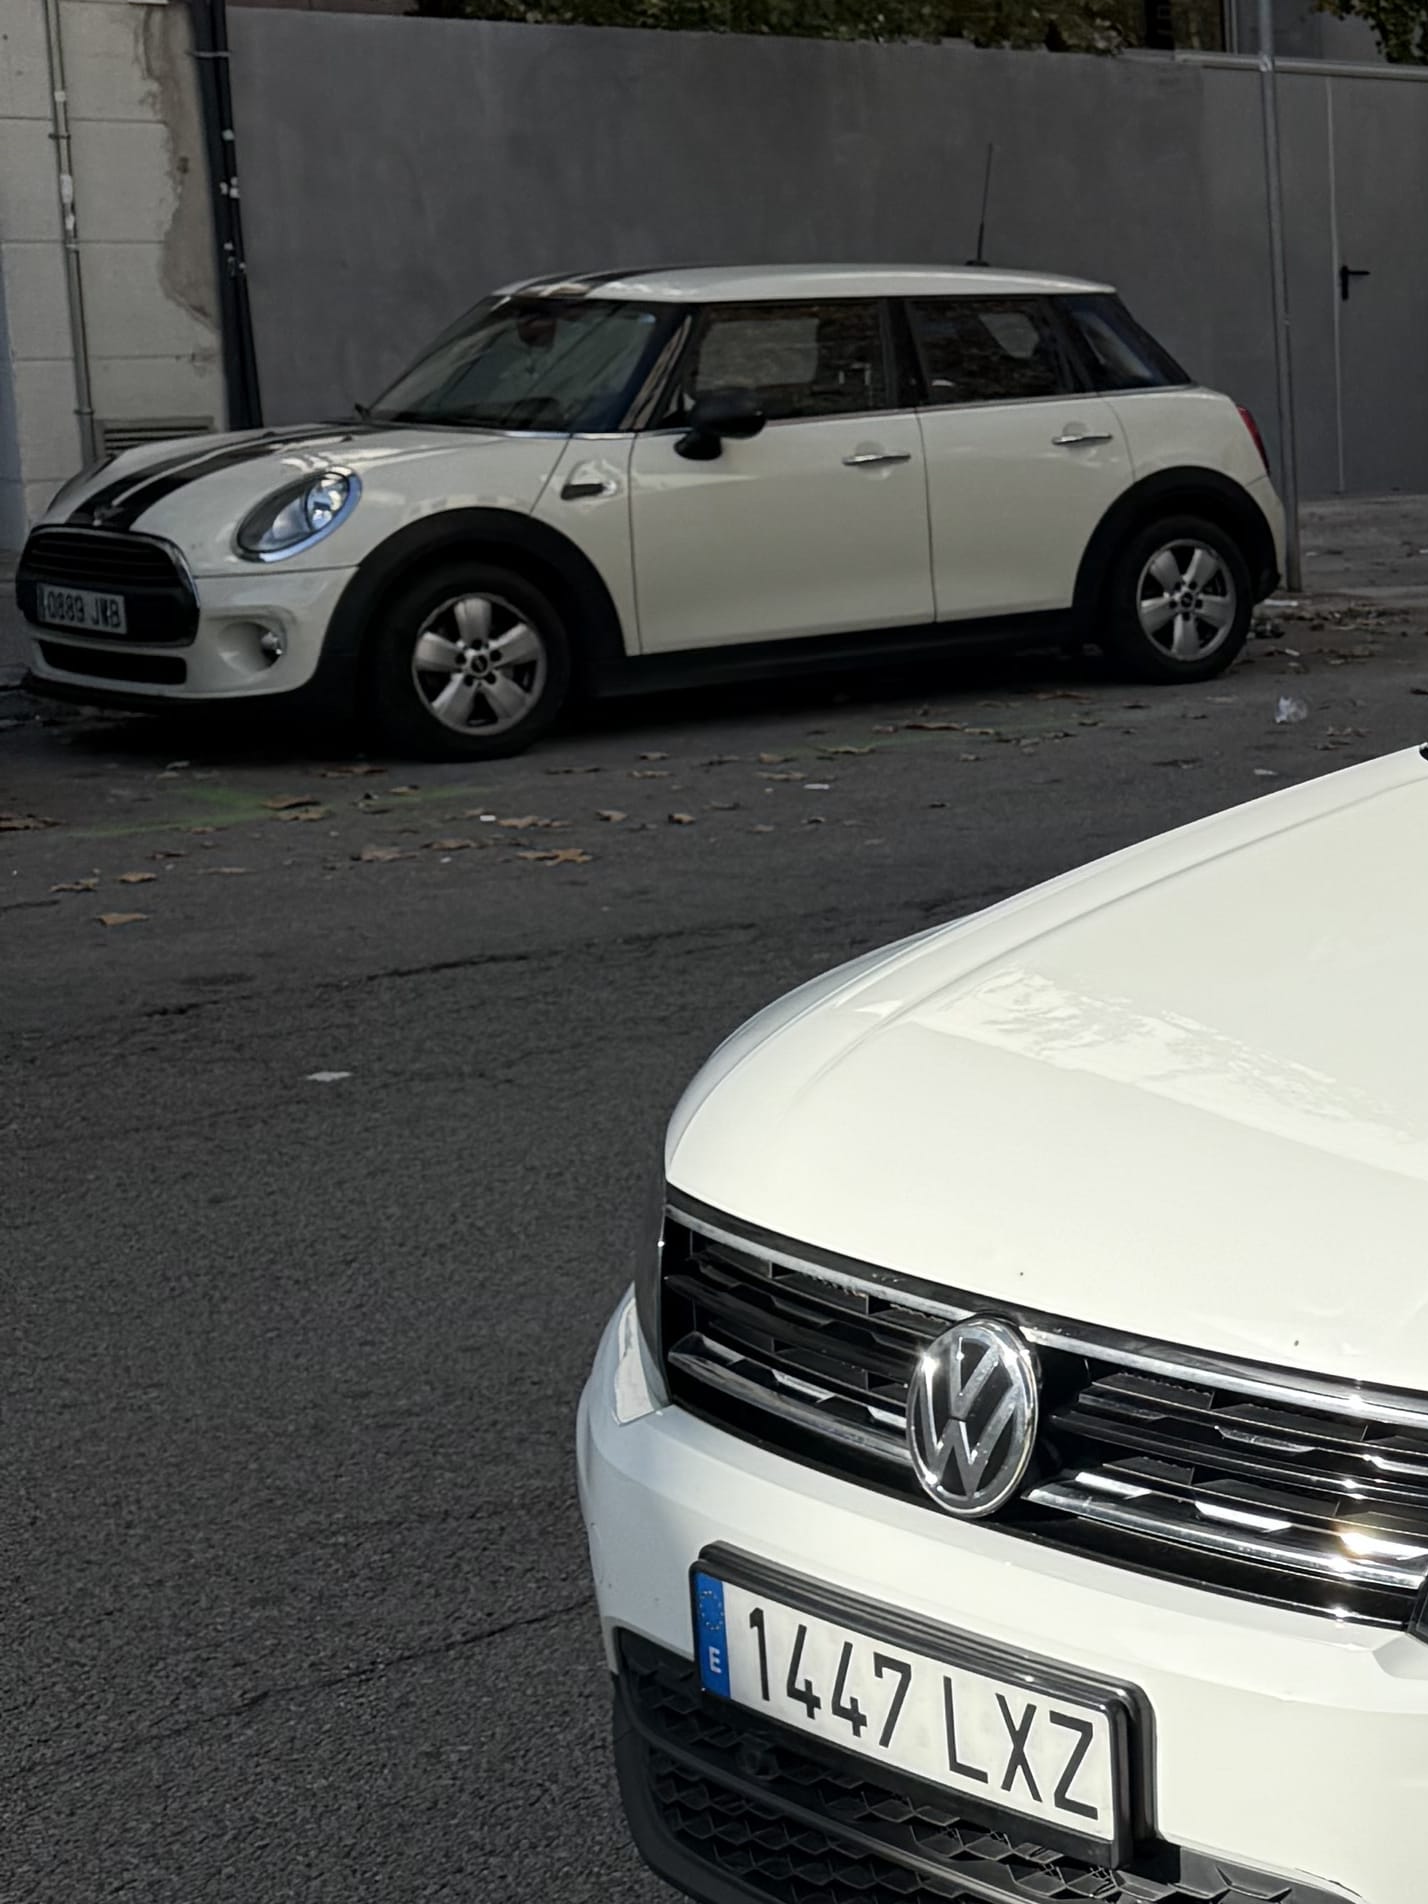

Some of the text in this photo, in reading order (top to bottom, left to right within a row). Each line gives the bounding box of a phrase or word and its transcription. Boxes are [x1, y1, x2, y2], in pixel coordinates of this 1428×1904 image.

[708, 1607, 1098, 1820] E 1447 LXZ
